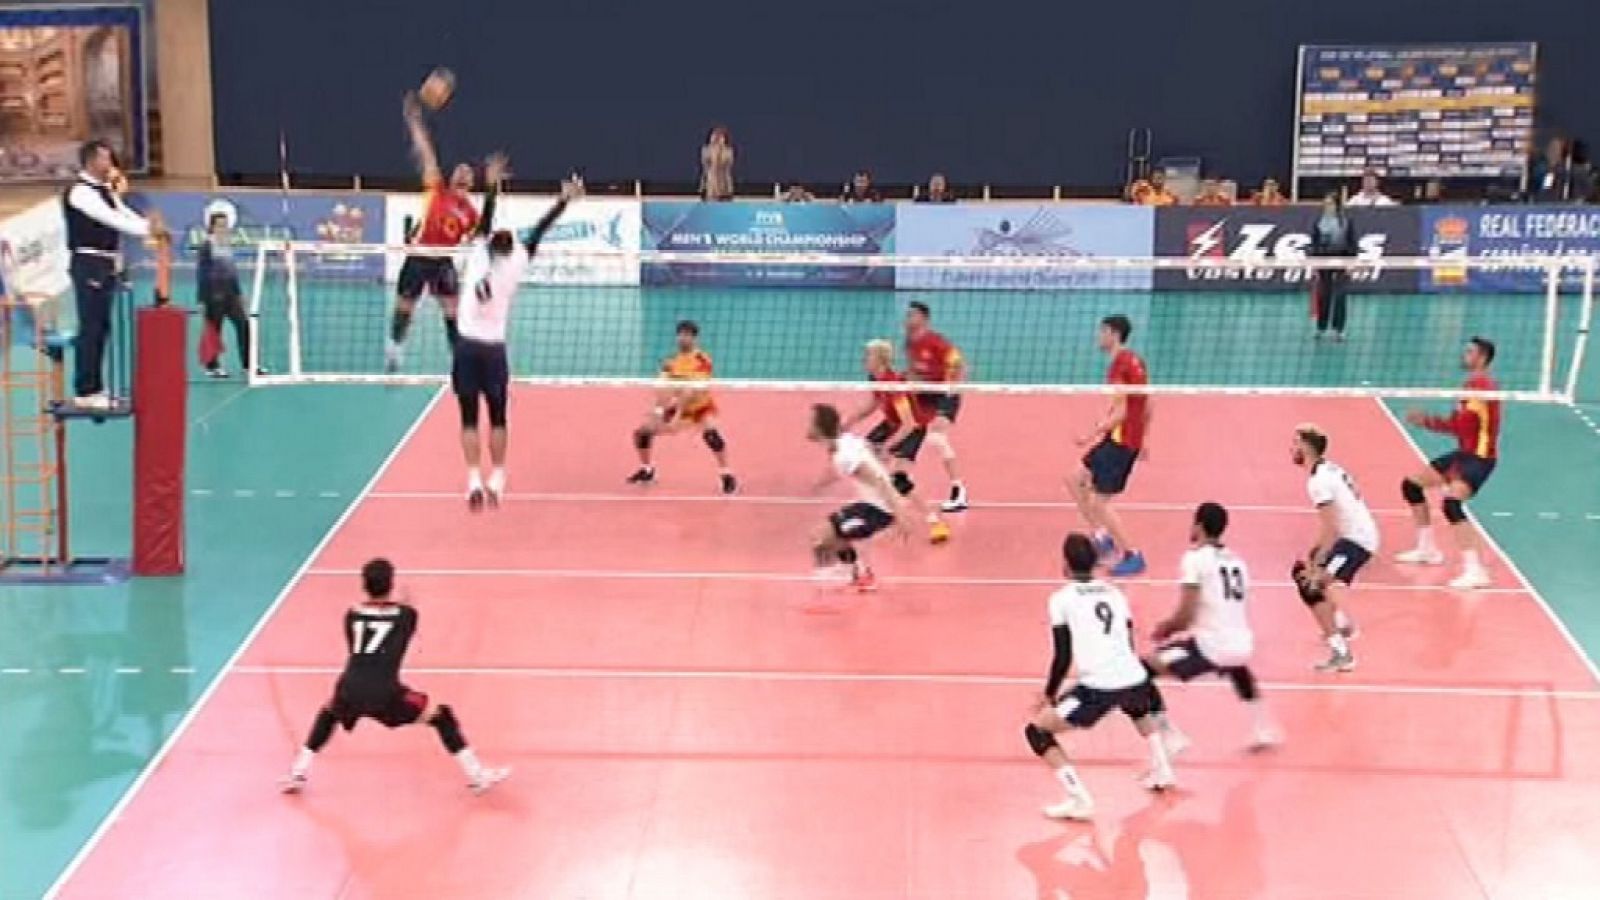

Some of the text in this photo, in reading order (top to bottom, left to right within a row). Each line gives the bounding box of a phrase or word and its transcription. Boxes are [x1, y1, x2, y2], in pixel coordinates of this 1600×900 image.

[716, 233, 762, 245] WORLD
[765, 233, 867, 247] CHAMPIONSHIP
[1479, 213, 1521, 238] REAL
[1229, 224, 1387, 261] Zes
[1095, 601, 1113, 635] 9
[351, 621, 394, 654] 17
